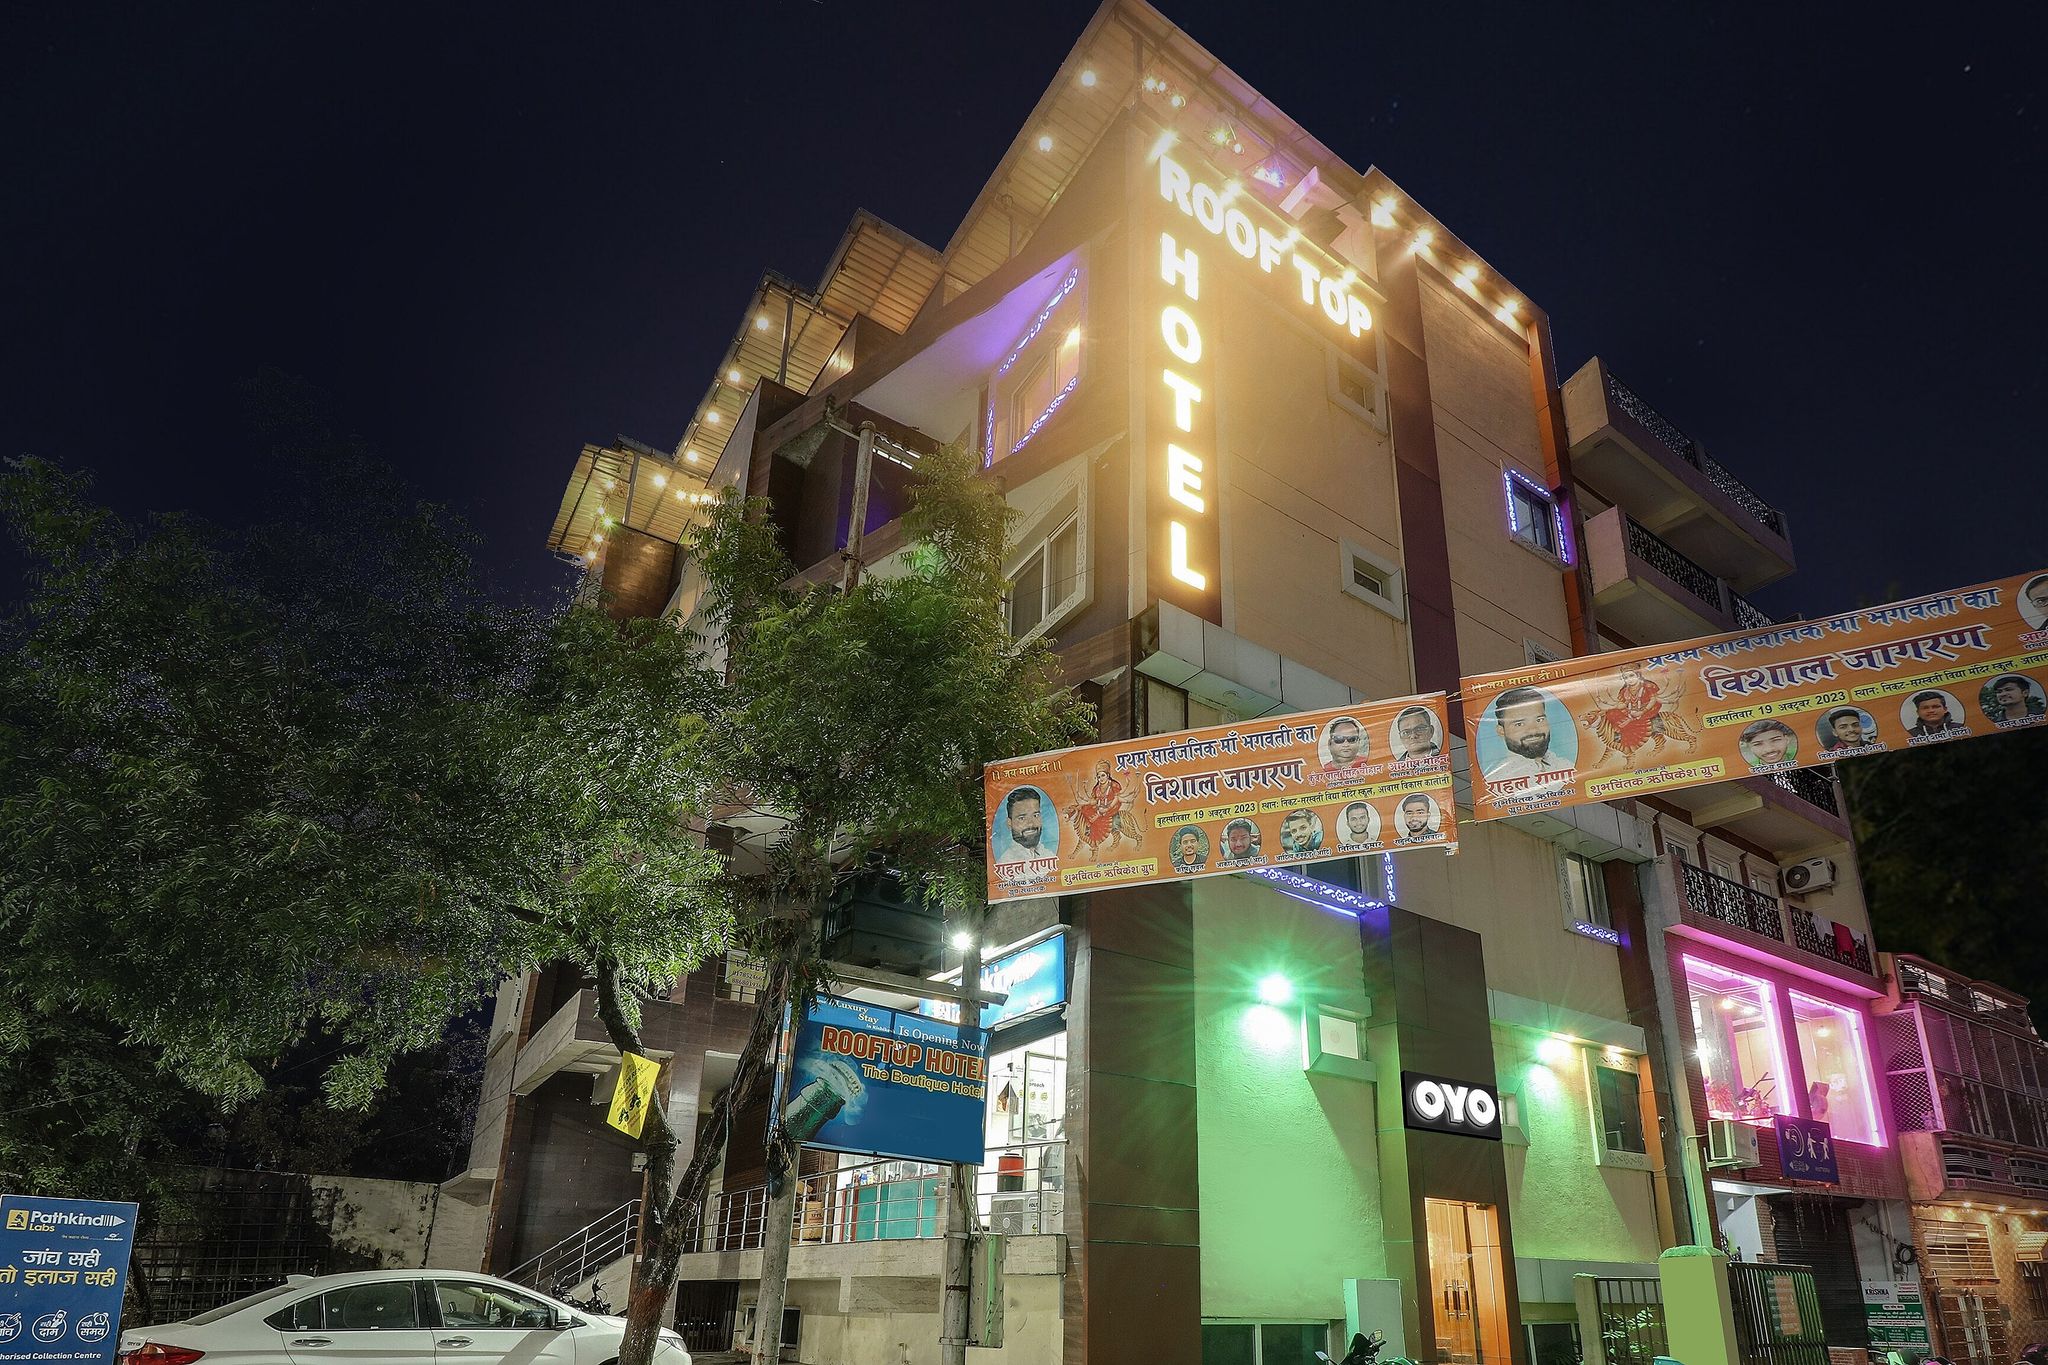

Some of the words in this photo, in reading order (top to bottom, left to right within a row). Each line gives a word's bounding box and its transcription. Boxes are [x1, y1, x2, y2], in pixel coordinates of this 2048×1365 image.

[1159, 153, 1282, 274] ROOF
[1292, 253, 1372, 339] TOP
[1160, 232, 1206, 591] HOTEL
[1961, 587, 2003, 609] का
[1701, 654, 1837, 701] विशाल
[1838, 624, 1992, 673] जागरण
[1759, 705, 1773, 715] 19
[1815, 692, 1846, 705] 2023
[1115, 752, 1148, 771] प्रथम
[1149, 738, 1218, 766] सार्वजनिक
[1220, 730, 1239, 756] माँ
[1242, 724, 1293, 752] भगवती
[1295, 724, 1317, 744] का
[1003, 768, 1017, 778] जय
[1019, 764, 1039, 776] माता
[1144, 770, 1220, 806] विशाल
[1221, 759, 1305, 792] जागरण
[1590, 777, 1644, 797] शुभचिंतक
[1701, 764, 1721, 779] ग्रुप
[1194, 810, 1204, 820] 19
[1234, 803, 1256, 814] 2023
[993, 861, 1026, 881] राहुल
[1029, 856, 1059, 872] राणा
[858, 1013, 879, 1024] Stay
[899, 1025, 910, 1037] Is
[913, 1029, 959, 1049] Opening
[961, 1039, 985, 1052] Now
[821, 1025, 922, 1068] ROOFTOP
[925, 1046, 988, 1082] HOTEL
[862, 1063, 889, 1080] The
[891, 1068, 949, 1092] Boutique
[951, 1084, 985, 1098] Hotel
[1412, 1080, 1496, 1127] OYO
[29, 1223, 55, 1232] Labs
[31, 1210, 105, 1227] Pathkind
[22, 1248, 63, 1266] जांच
[67, 1248, 101, 1268] सही
[23, 1269, 79, 1287] इलाज
[84, 1267, 118, 1287] सही
[39, 1327, 59, 1337] दाम
[80, 1327, 106, 1337] समय
